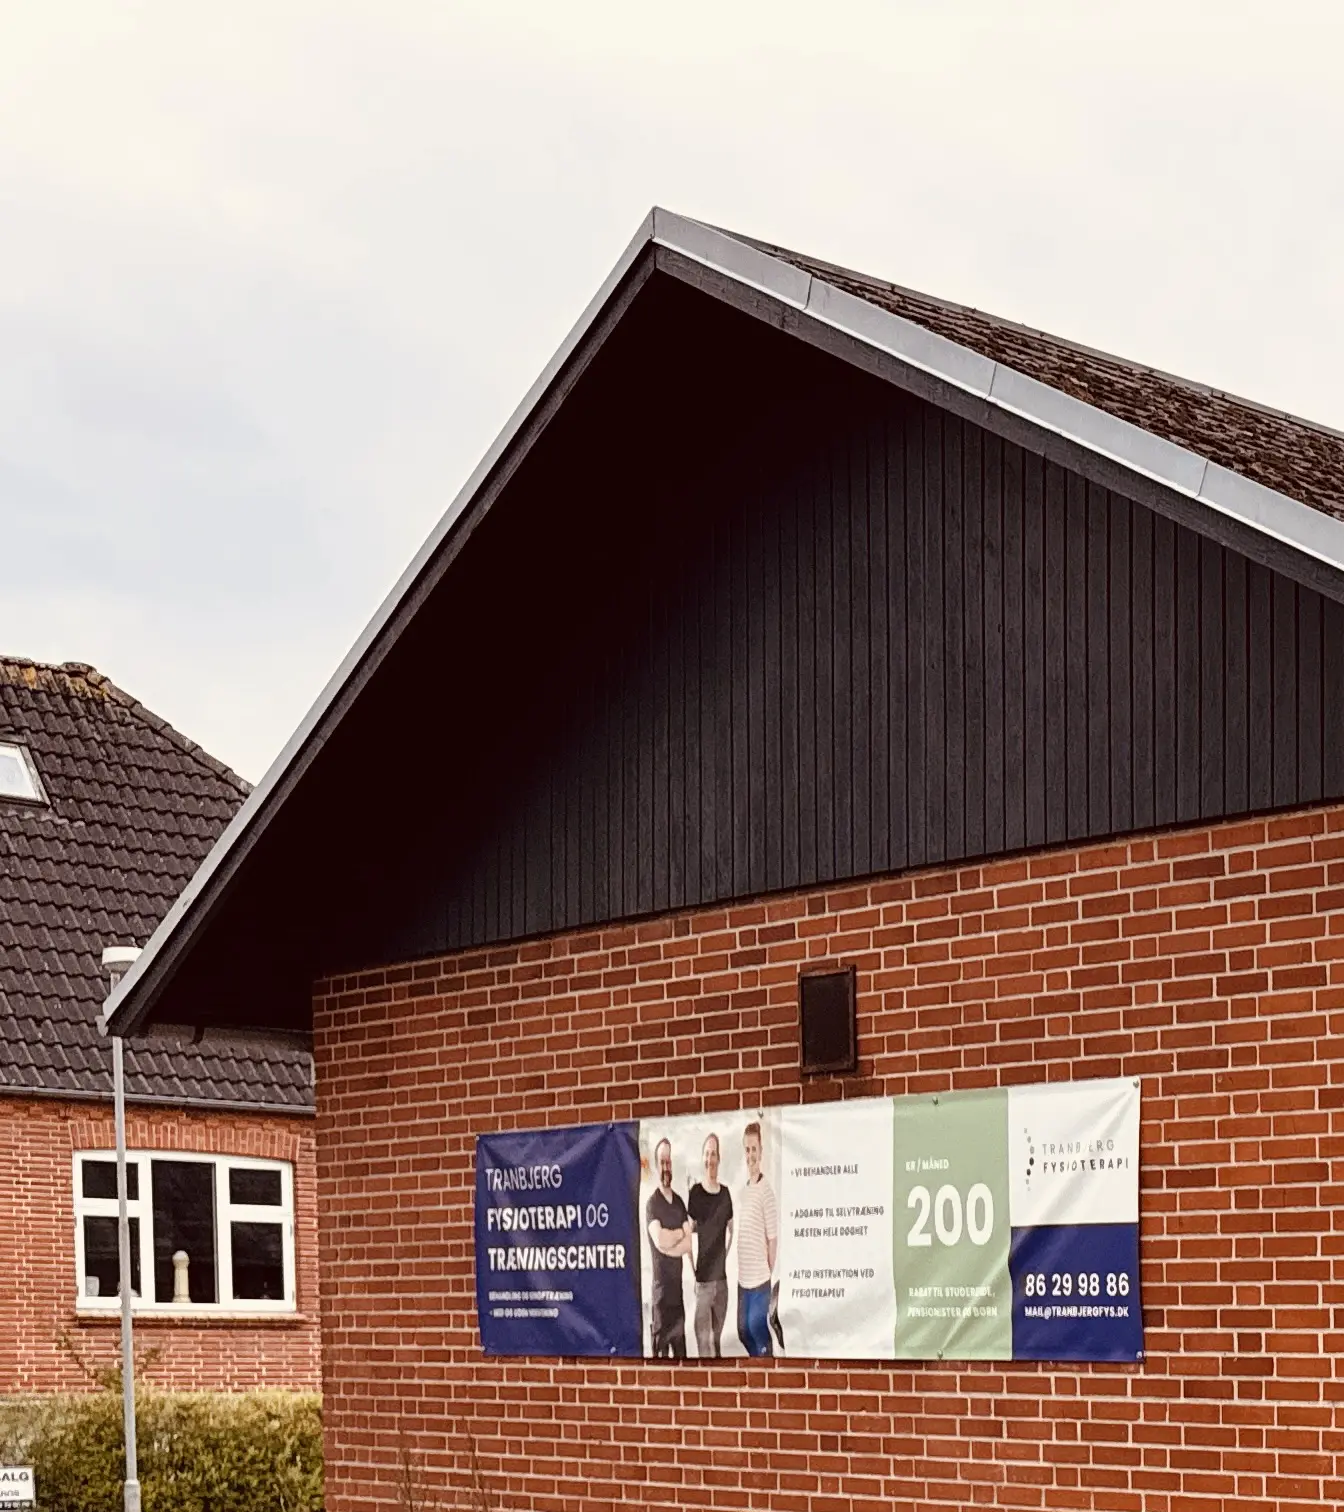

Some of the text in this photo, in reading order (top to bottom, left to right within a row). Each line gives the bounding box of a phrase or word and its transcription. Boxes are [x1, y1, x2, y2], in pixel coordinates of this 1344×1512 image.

[486, 1164, 562, 1191] TRANBJERG
[843, 1164, 858, 1175] ALLE
[1043, 1157, 1129, 1173] FYSIOTERAPI
[487, 1203, 609, 1231] FYSIOTERAPI OG
[907, 1183, 994, 1247] 200
[488, 1244, 625, 1271] TRÆNINGSCENTER
[1025, 1272, 1129, 1297] 86 29 98 86
[1024, 1306, 1129, 1320] MAIL@TRANBJERGFYS.DK
